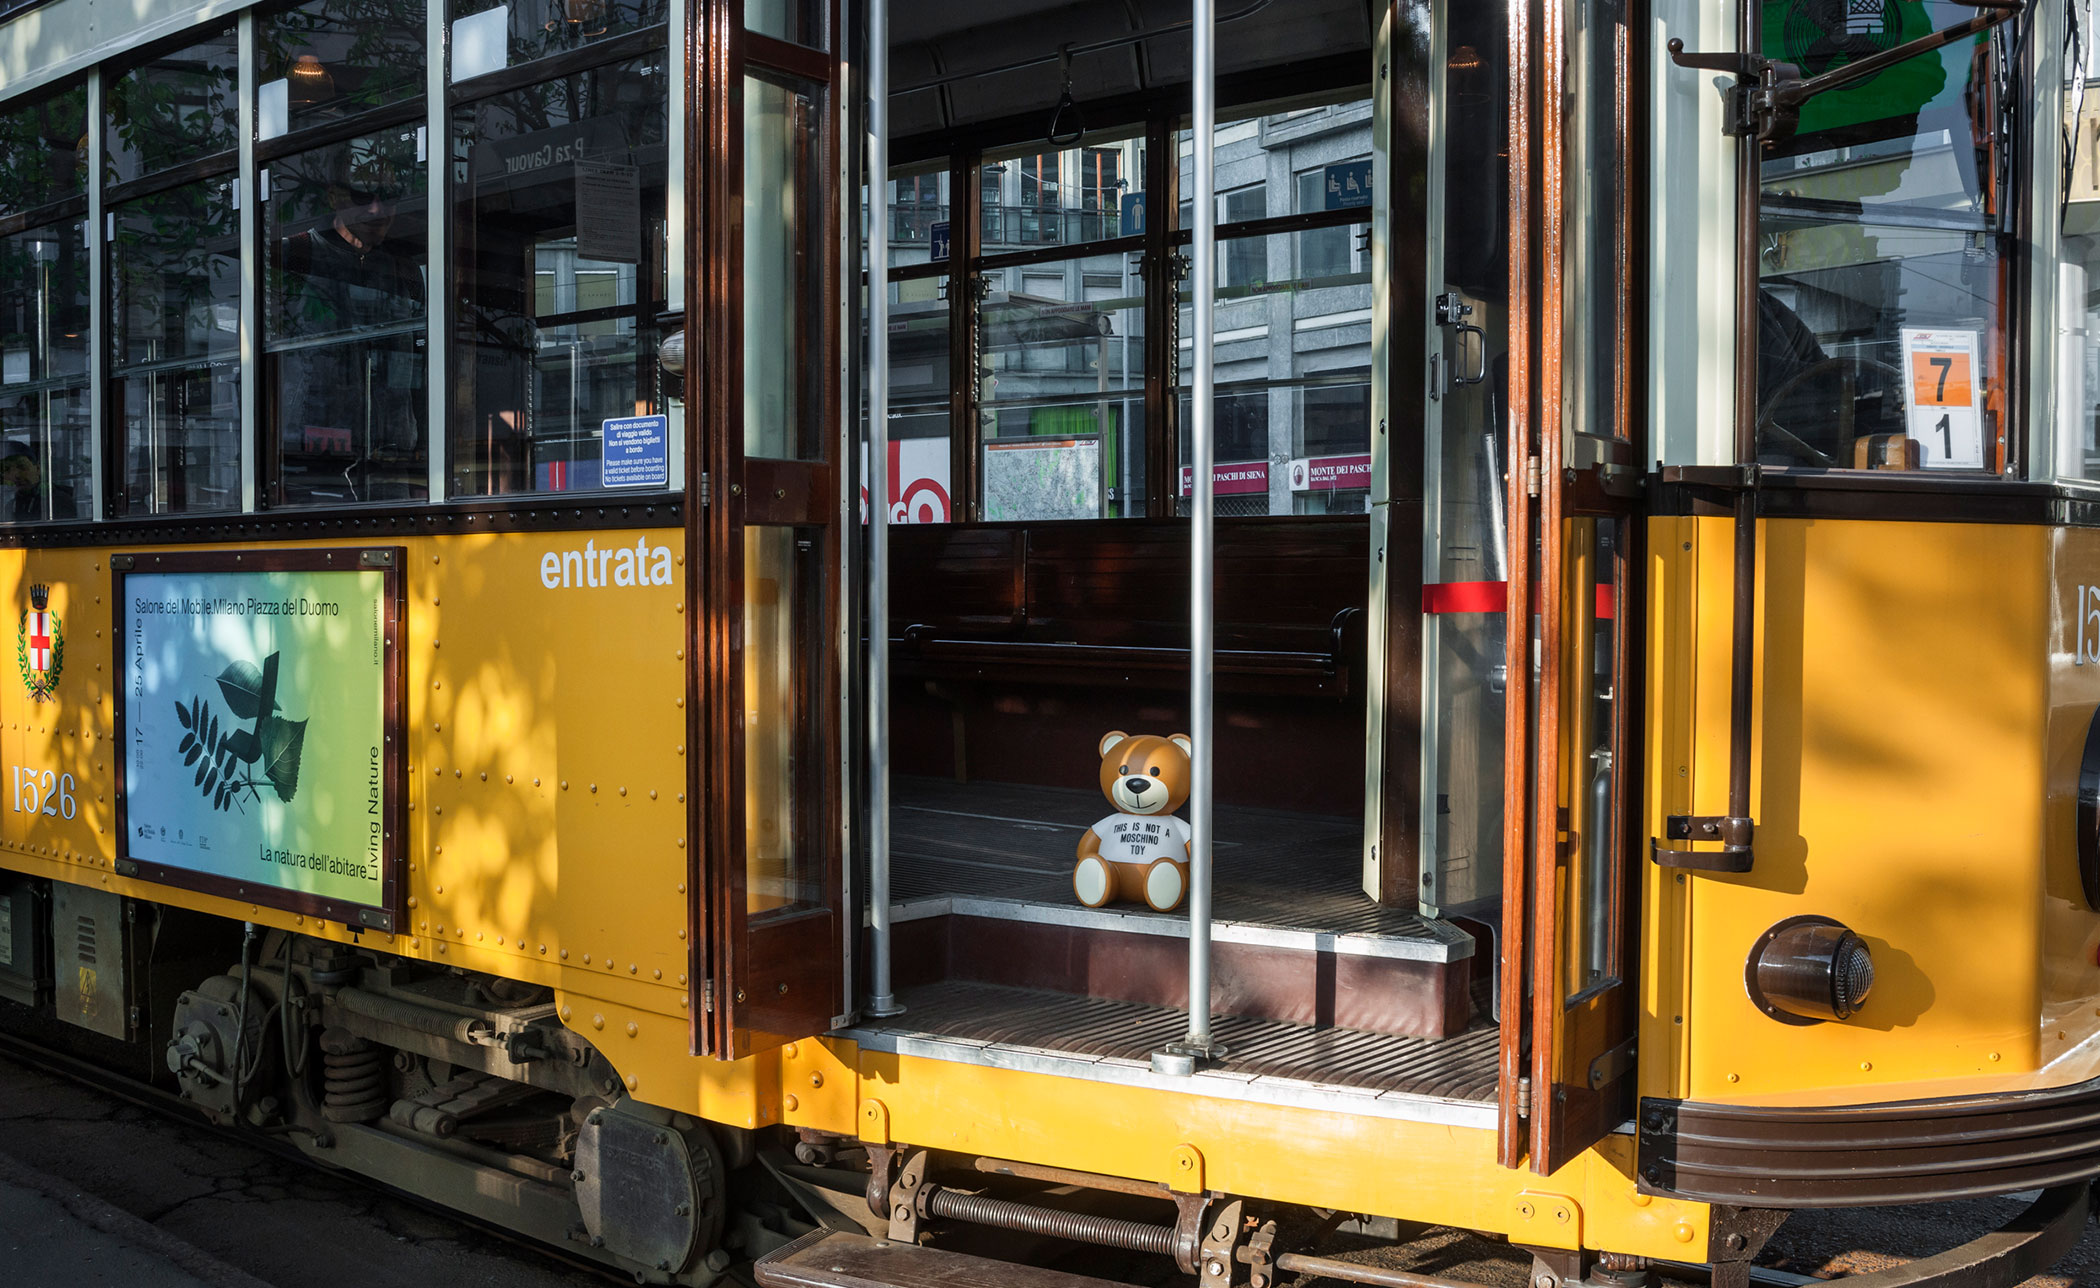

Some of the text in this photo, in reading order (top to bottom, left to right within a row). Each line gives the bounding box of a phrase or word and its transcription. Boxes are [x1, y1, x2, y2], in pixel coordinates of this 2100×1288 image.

[1930, 358, 1952, 401] 7
[622, 430, 638, 438] viaggio
[643, 436, 660, 445] biglietti
[1936, 414, 1952, 459] 1
[1217, 472, 1238, 482] PASCHI
[1239, 472, 1246, 480] DI
[1247, 470, 1265, 480] SIENA
[1311, 466, 1335, 476] MONTE
[1336, 465, 1348, 474] DEI
[541, 535, 673, 589] entrata
[135, 598, 338, 616] Salone del Mobile.Milano Piazza del Duomo
[135, 618, 143, 670] Aprile
[135, 676, 143, 696] 25
[136, 728, 143, 745] 17
[13, 766, 76, 820] 1526
[368, 746, 380, 881] Living Nature
[1114, 822, 1170, 838] THIS IS NOT A
[1120, 834, 1158, 845] MOSCHINO
[1131, 845, 1146, 855] TOY
[260, 844, 367, 879] La natura dell'abitare
